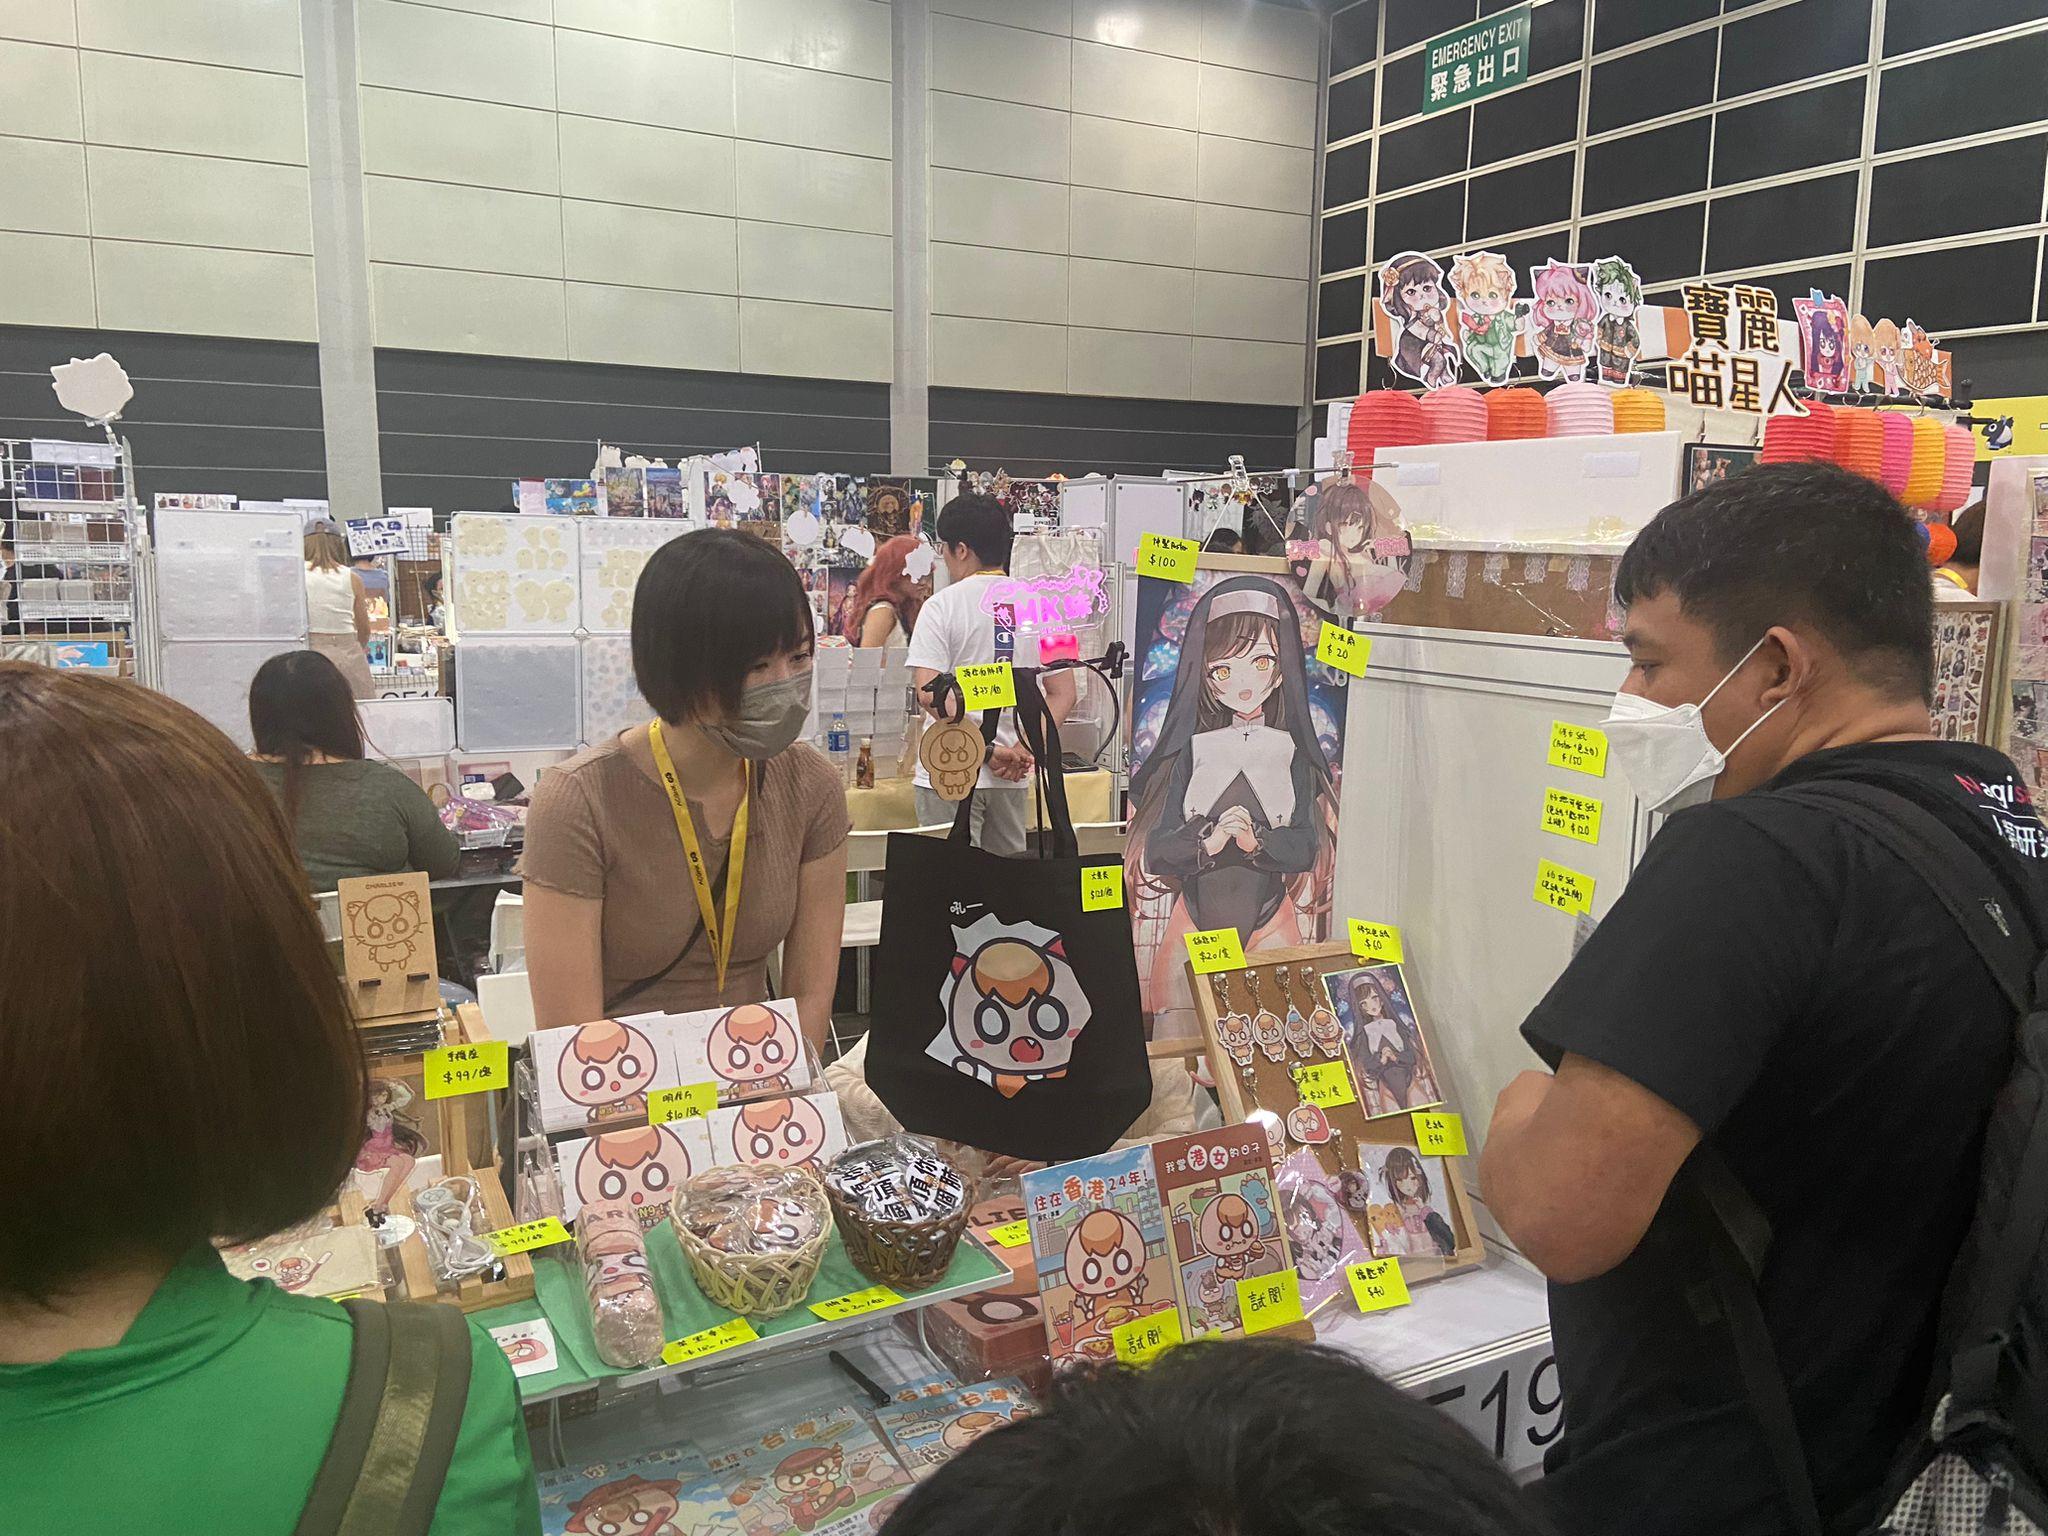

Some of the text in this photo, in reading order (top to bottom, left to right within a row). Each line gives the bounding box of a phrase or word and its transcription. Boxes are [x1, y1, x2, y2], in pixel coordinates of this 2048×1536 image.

[1432, 18, 1523, 69] EMERGENCY EXIT
[1430, 46, 1520, 102] 緊急出口
[1683, 282, 1780, 352] 寶麗
[1668, 350, 1806, 414] 喵星人
[1149, 553, 1176, 568] $100
[1422, 1355, 1566, 1461] 19
